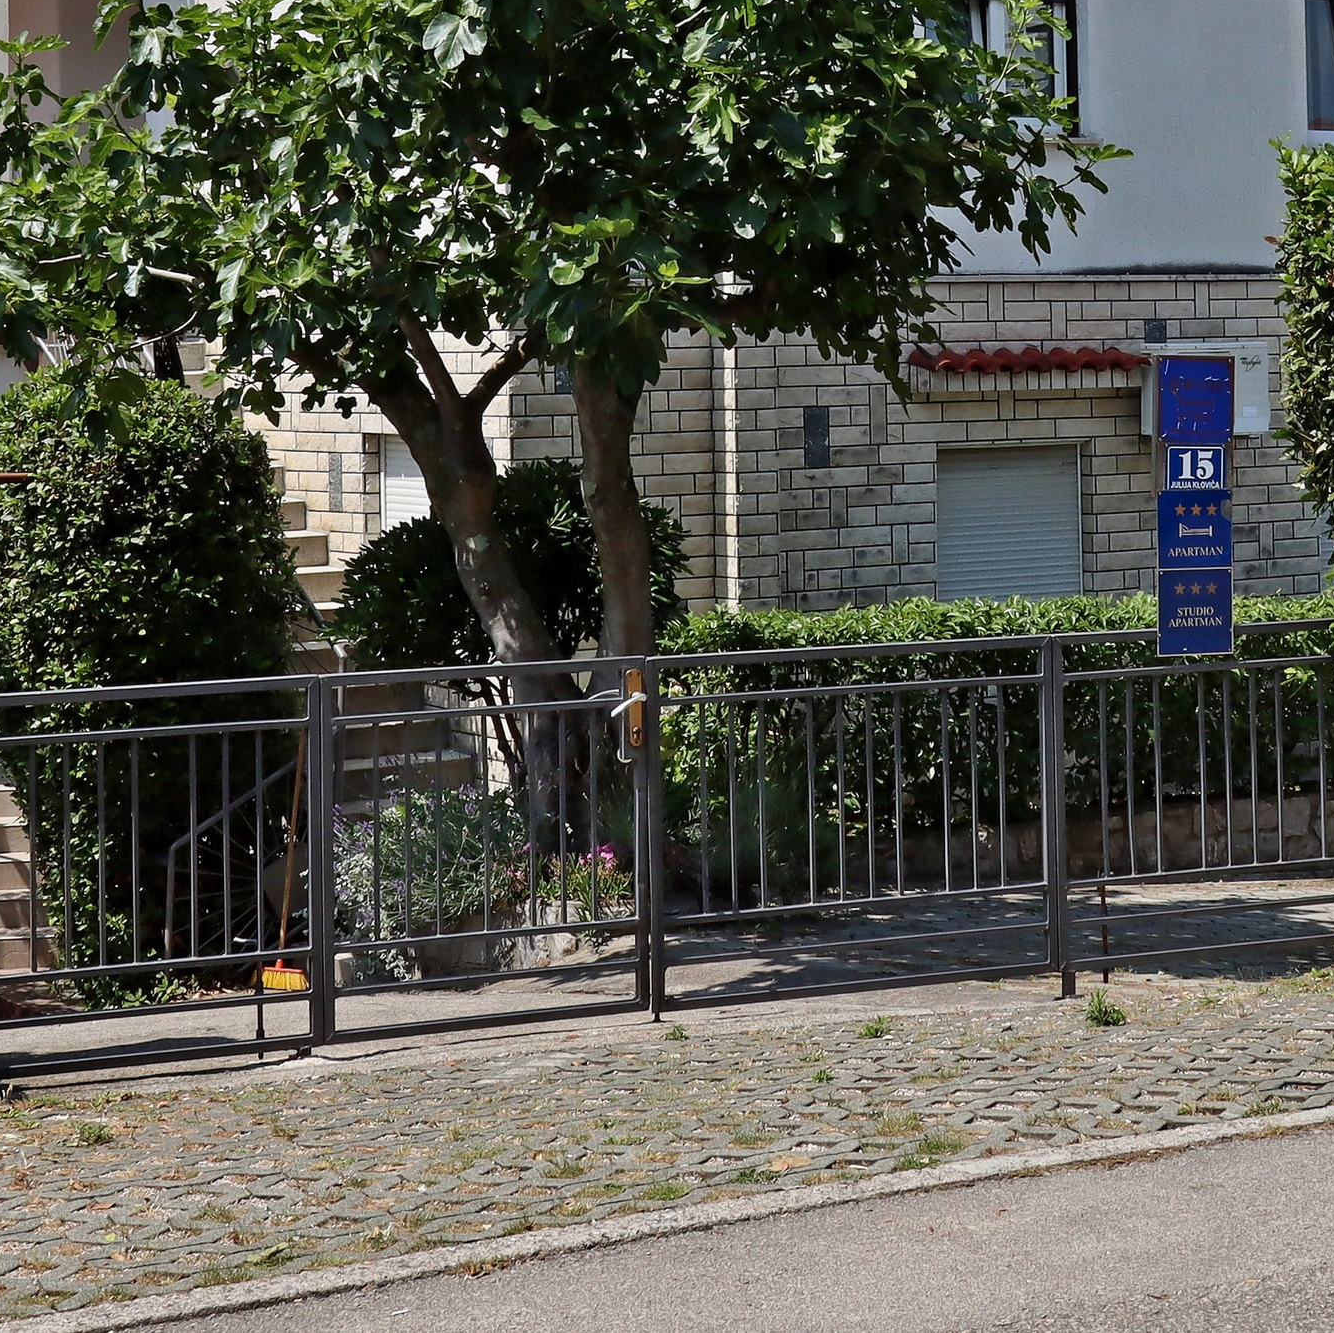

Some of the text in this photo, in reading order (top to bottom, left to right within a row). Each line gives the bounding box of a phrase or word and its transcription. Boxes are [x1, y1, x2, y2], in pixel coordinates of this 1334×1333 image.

[1178, 450, 1214, 480] 15
[1170, 481, 1192, 489] JULIJA
[1167, 546, 1224, 558] APARTMAN
[1177, 606, 1214, 617] STUDIO
[1168, 616, 1223, 628] APARTMAN
